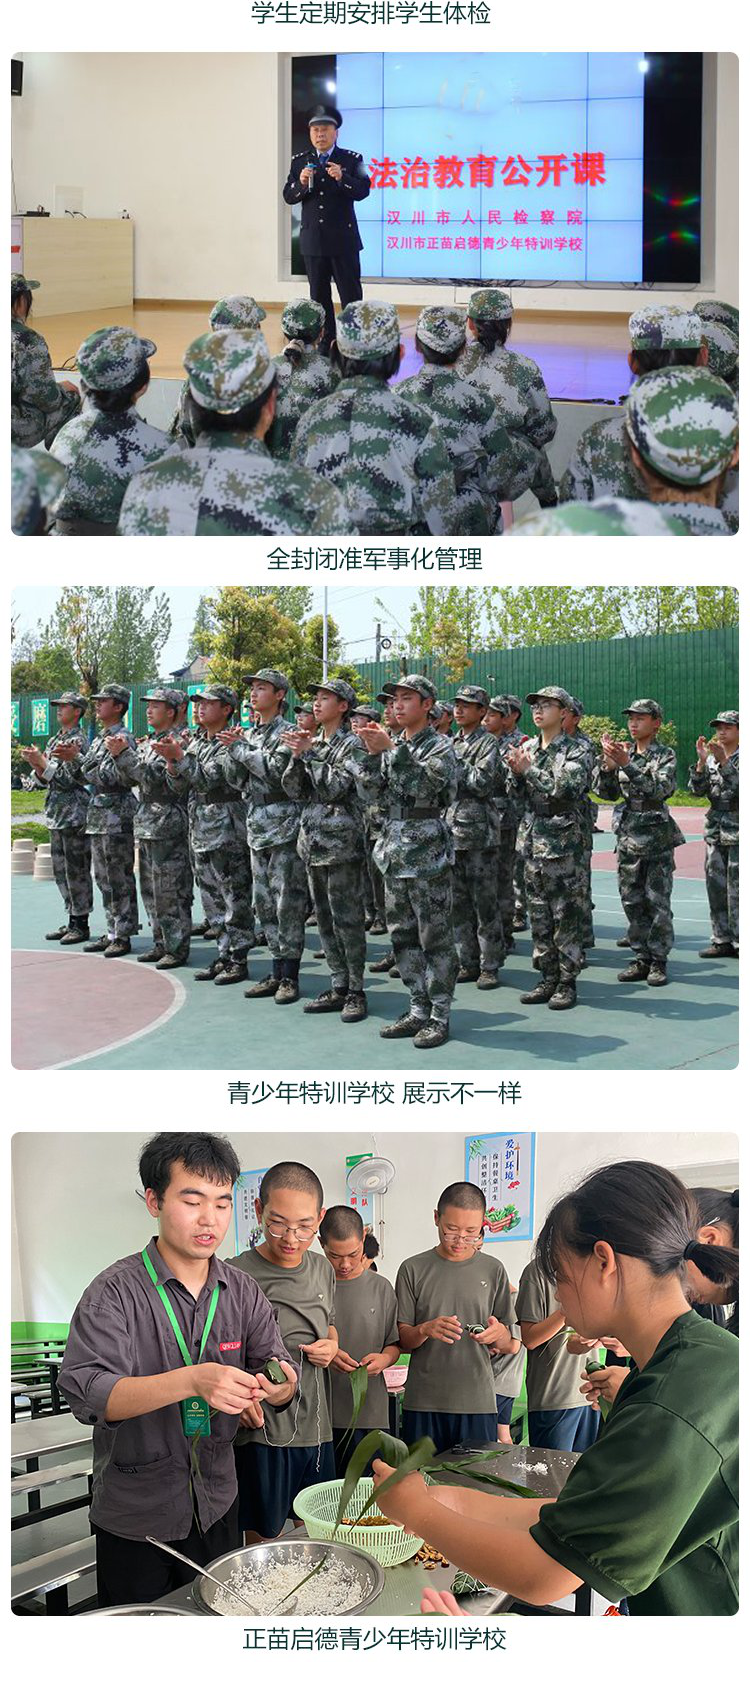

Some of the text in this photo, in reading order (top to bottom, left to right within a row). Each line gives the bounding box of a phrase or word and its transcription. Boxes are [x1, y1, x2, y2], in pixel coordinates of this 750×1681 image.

[368, 151, 606, 189] 法治教育公开课
[387, 210, 583, 226] 汉川市人民检察院
[387, 235, 583, 251] 汉川市正苗启德青少年特训学校
[480, 1155, 488, 1195] 共创整洁环
[504, 1138, 515, 1181] 爱护环境
